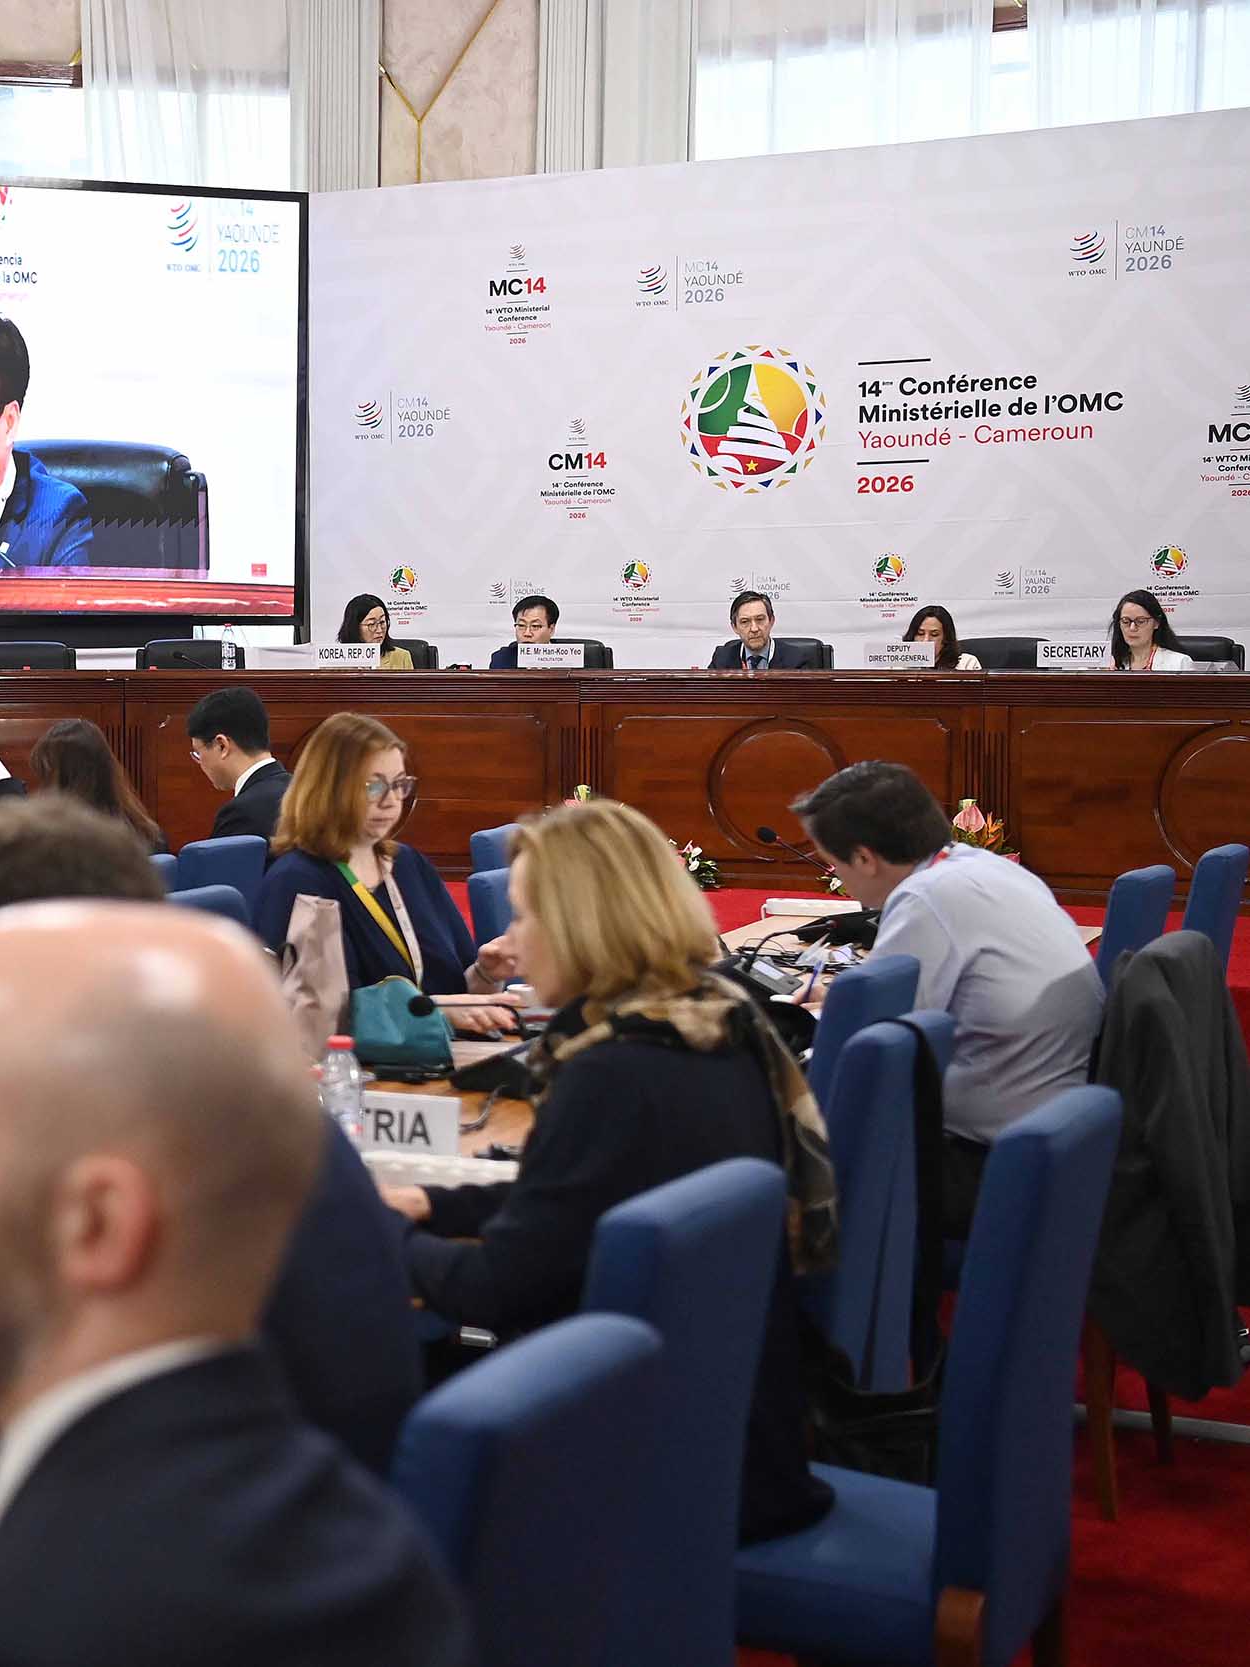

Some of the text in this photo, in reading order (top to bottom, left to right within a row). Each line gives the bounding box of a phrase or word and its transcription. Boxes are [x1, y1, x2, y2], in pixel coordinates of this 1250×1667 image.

[1125, 225, 1165, 239] CM14
[1125, 235, 1184, 254] YAUNDÉ
[217, 249, 260, 272] 2026
[685, 261, 718, 273] MC14
[1125, 254, 1172, 272] 2026
[3, 270, 10, 283] la
[13, 271, 38, 284] OMC
[684, 270, 743, 287] YAOUNDÉ
[489, 276, 547, 297] MC14
[685, 288, 724, 304] 2026
[514, 304, 550, 313] Ministerial
[498, 314, 537, 323] Conference
[509, 337, 527, 345] 2026
[899, 374, 1038, 397] Conférence
[398, 397, 429, 409] CM14
[397, 407, 451, 421] YAOUNDÉ
[858, 399, 1002, 424] Ministérielle
[1008, 397, 1038, 416] de
[398, 423, 434, 438] 2026
[858, 426, 951, 449] Yaoundé
[974, 423, 1094, 444] Cameroun
[548, 451, 607, 471] CM14
[1215, 455, 1238, 463] WTO
[1200, 473, 1235, 482] Yaoundé
[857, 475, 914, 494] 2026
[540, 489, 582, 497] Ministérielle
[577, 497, 611, 505] Cameroun
[1024, 585, 1050, 594] 2026
[318, 648, 375, 660] KOREA, REP. OF
[520, 647, 582, 655] H.E. Mr Han-Koo Yeo
[886, 645, 910, 653] DEPUTY
[1042, 646, 1106, 658] SECRETARY
[868, 654, 930, 662] DIRECTOR-GENERAL
